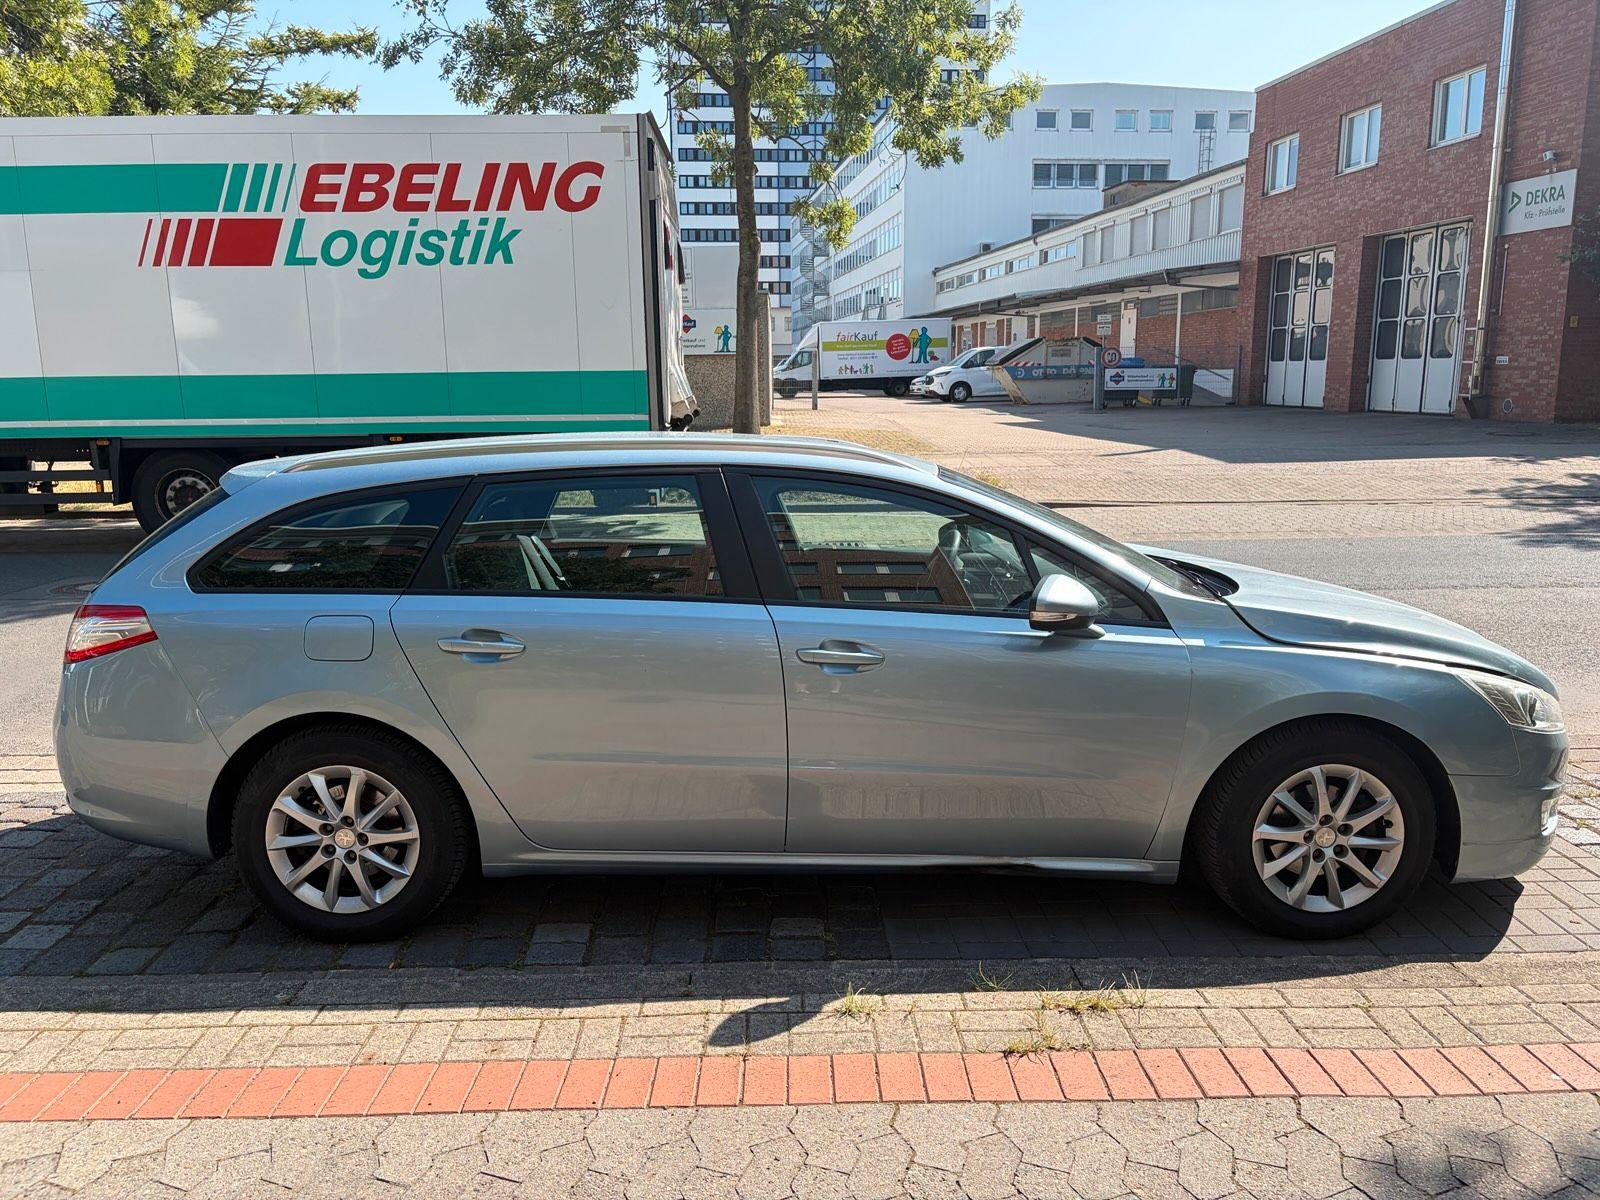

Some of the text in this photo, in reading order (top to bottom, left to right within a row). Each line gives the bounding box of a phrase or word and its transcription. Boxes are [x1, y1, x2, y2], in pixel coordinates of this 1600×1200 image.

[299, 161, 604, 213] EBELING
[1525, 184, 1566, 207] DEKRA
[1524, 210, 1534, 220] Kfz
[1538, 206, 1566, 218] Prüfstelle
[283, 216, 521, 280] Logistik
[836, 330, 879, 343] fairKauf
